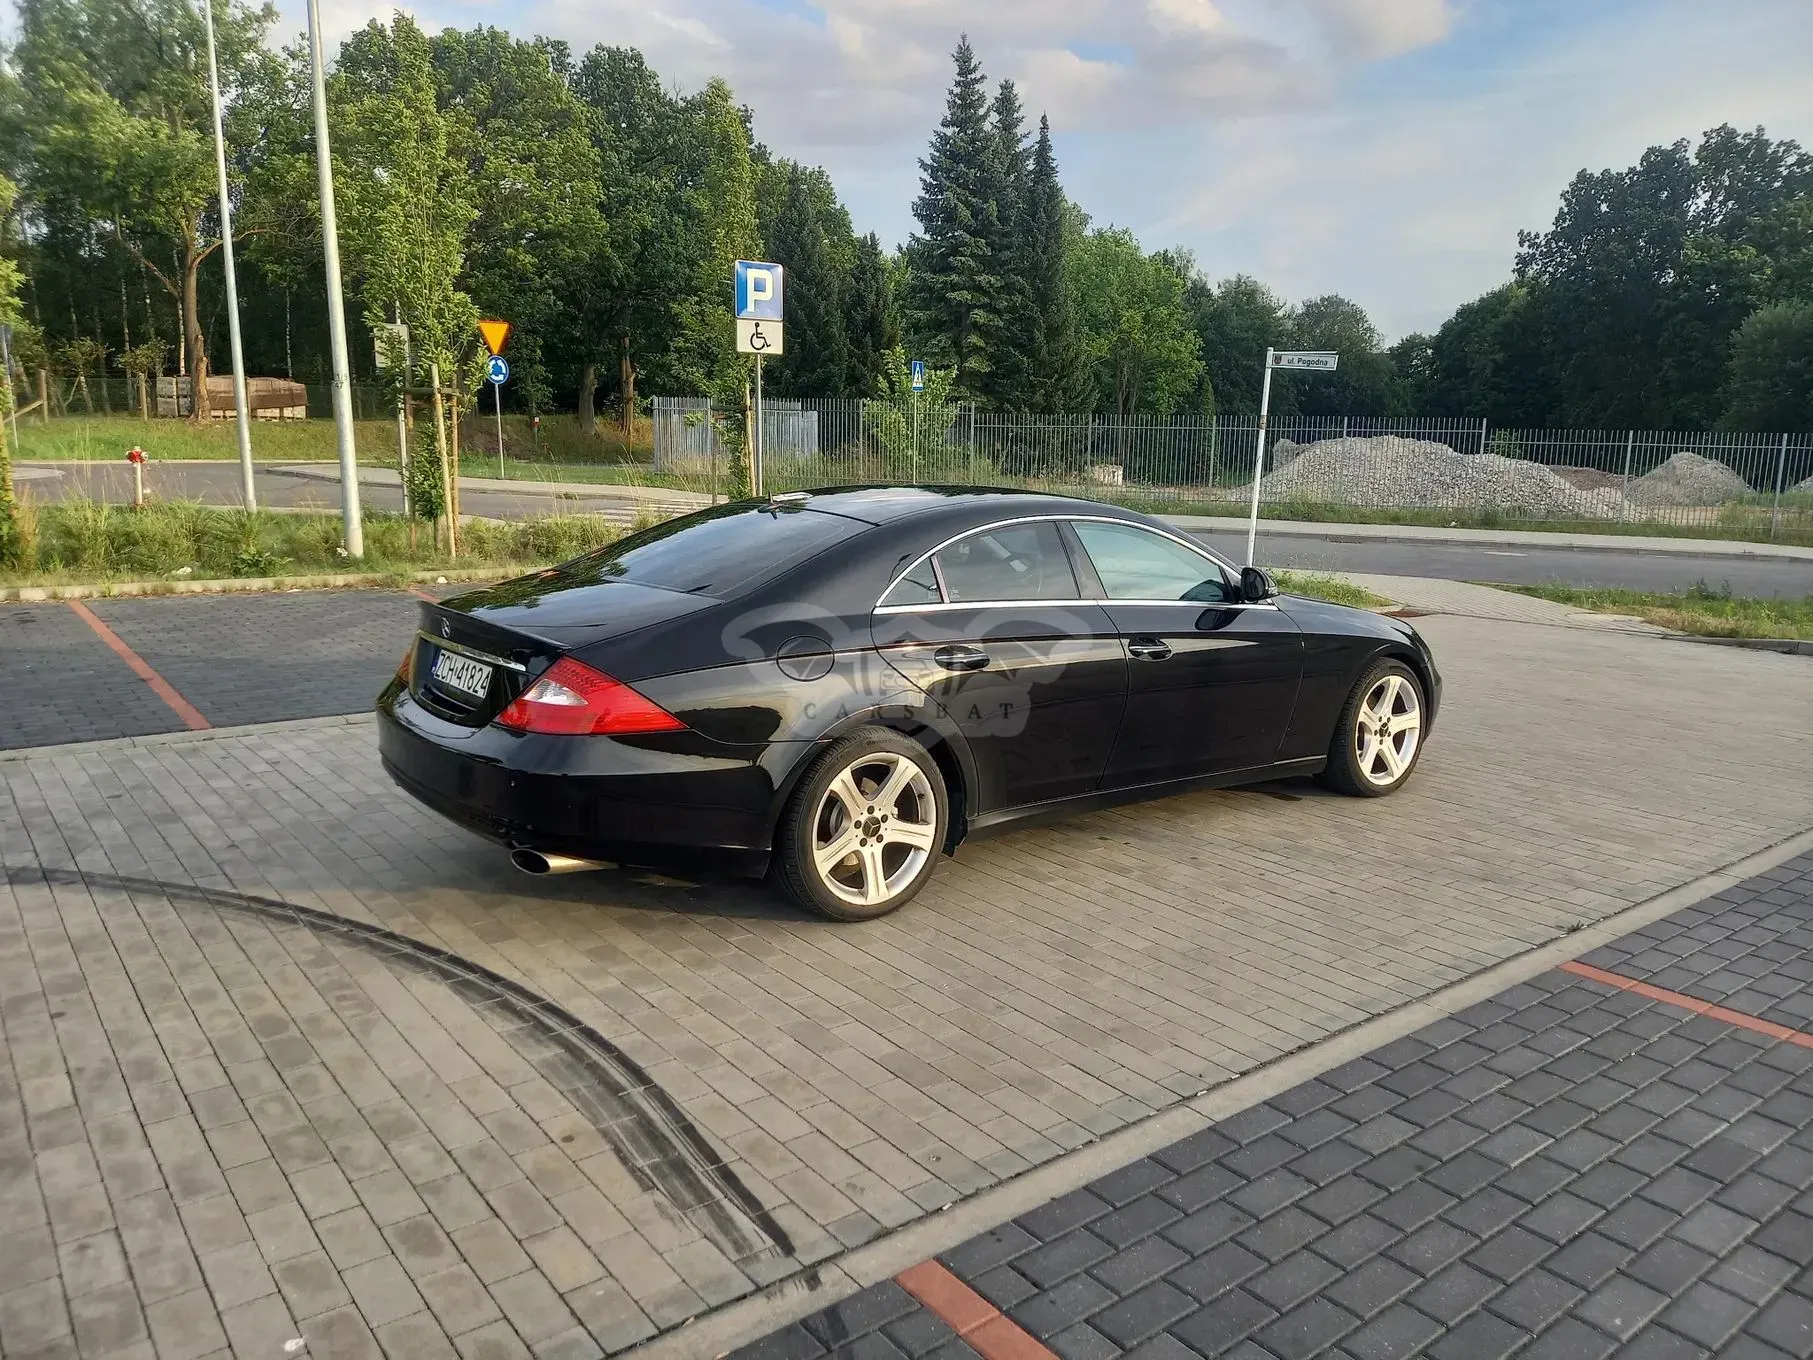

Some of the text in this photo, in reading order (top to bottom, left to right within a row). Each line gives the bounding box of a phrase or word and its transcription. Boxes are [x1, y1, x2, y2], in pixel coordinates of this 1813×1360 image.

[746, 268, 773, 313] P
[1297, 357, 1328, 367] Pogodna
[434, 652, 491, 697] ZCH 41824
